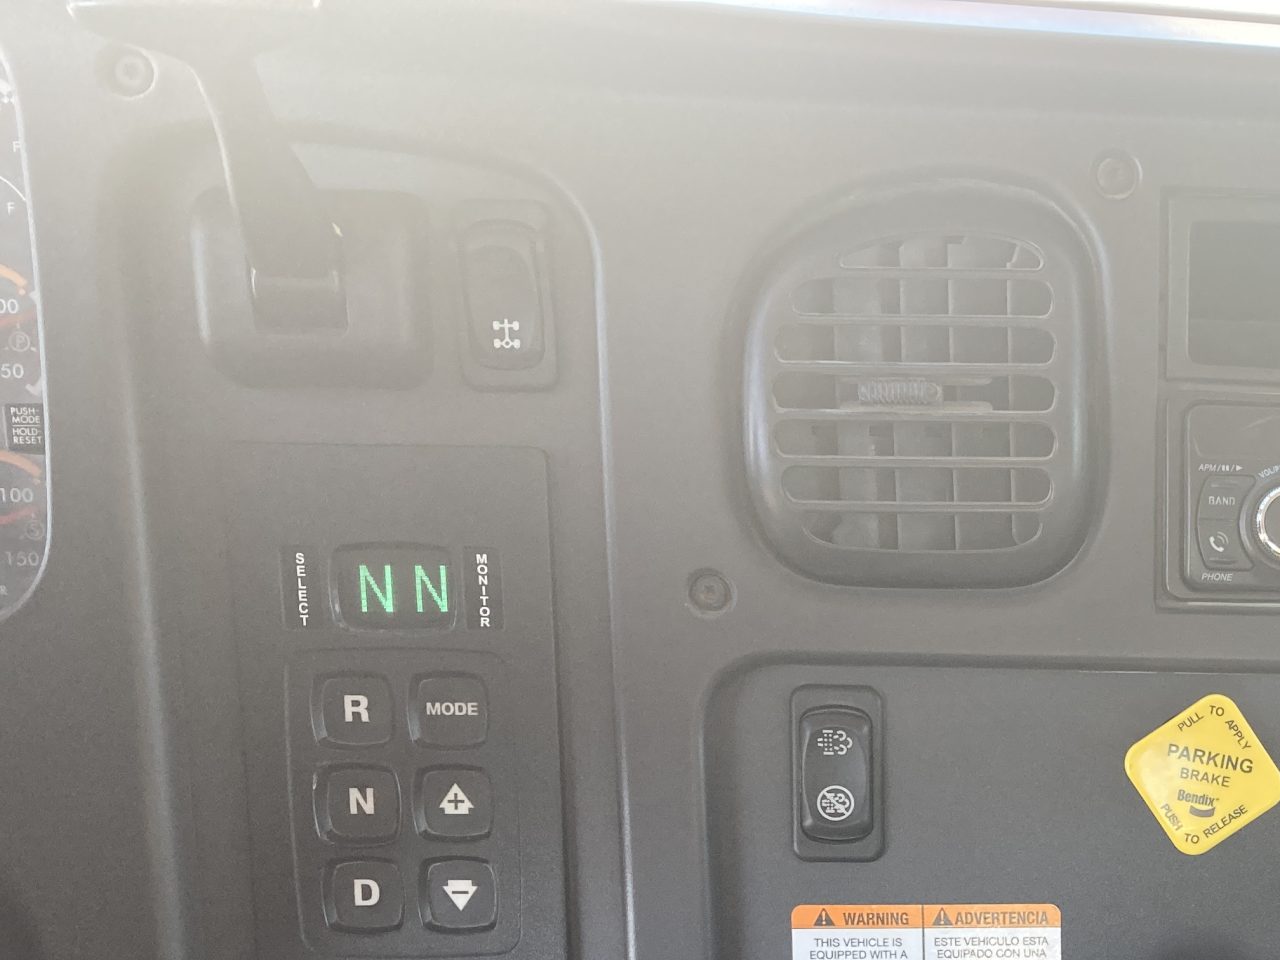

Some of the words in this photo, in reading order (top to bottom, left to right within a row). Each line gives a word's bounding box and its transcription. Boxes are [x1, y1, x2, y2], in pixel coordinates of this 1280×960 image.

[8, 202, 15, 215] F
[13, 436, 42, 444] RESET
[1209, 496, 1236, 506] BAND
[6, 551, 39, 566] 150
[1201, 573, 1233, 582] PHONE
[296, 553, 309, 626] SELECT
[359, 565, 394, 612] N
[415, 565, 448, 612] N
[476, 554, 490, 627] MONITOR
[344, 695, 370, 722] R
[426, 702, 479, 716] MODE
[1177, 712, 1205, 732] PULL
[1209, 705, 1225, 717] TO
[1225, 719, 1252, 750] APPLY
[1168, 744, 1254, 774] PARKING
[1180, 767, 1231, 788] BRAKE
[349, 788, 375, 815] N
[1178, 789, 1215, 807] Bendix
[1160, 803, 1183, 831] PUSH
[1184, 833, 1200, 844] TO
[1203, 805, 1249, 838] RELEASE
[354, 879, 380, 906] D
[843, 912, 909, 926] WARNING
[955, 912, 1049, 925] ADVERTENCIA
[814, 938, 840, 948] THIS
[843, 938, 889, 947] VEHICLE
[892, 938, 903, 947] IS
[934, 937, 961, 947] ESTE
[1022, 937, 1049, 946] ESTA
[810, 951, 867, 960] EQUIPPED
[871, 951, 898, 960] WITH
[900, 950, 908, 959] A
[937, 949, 993, 959] EQUIPADO
[995, 949, 1021, 958] CON
[1024, 949, 1047, 958] UNA
